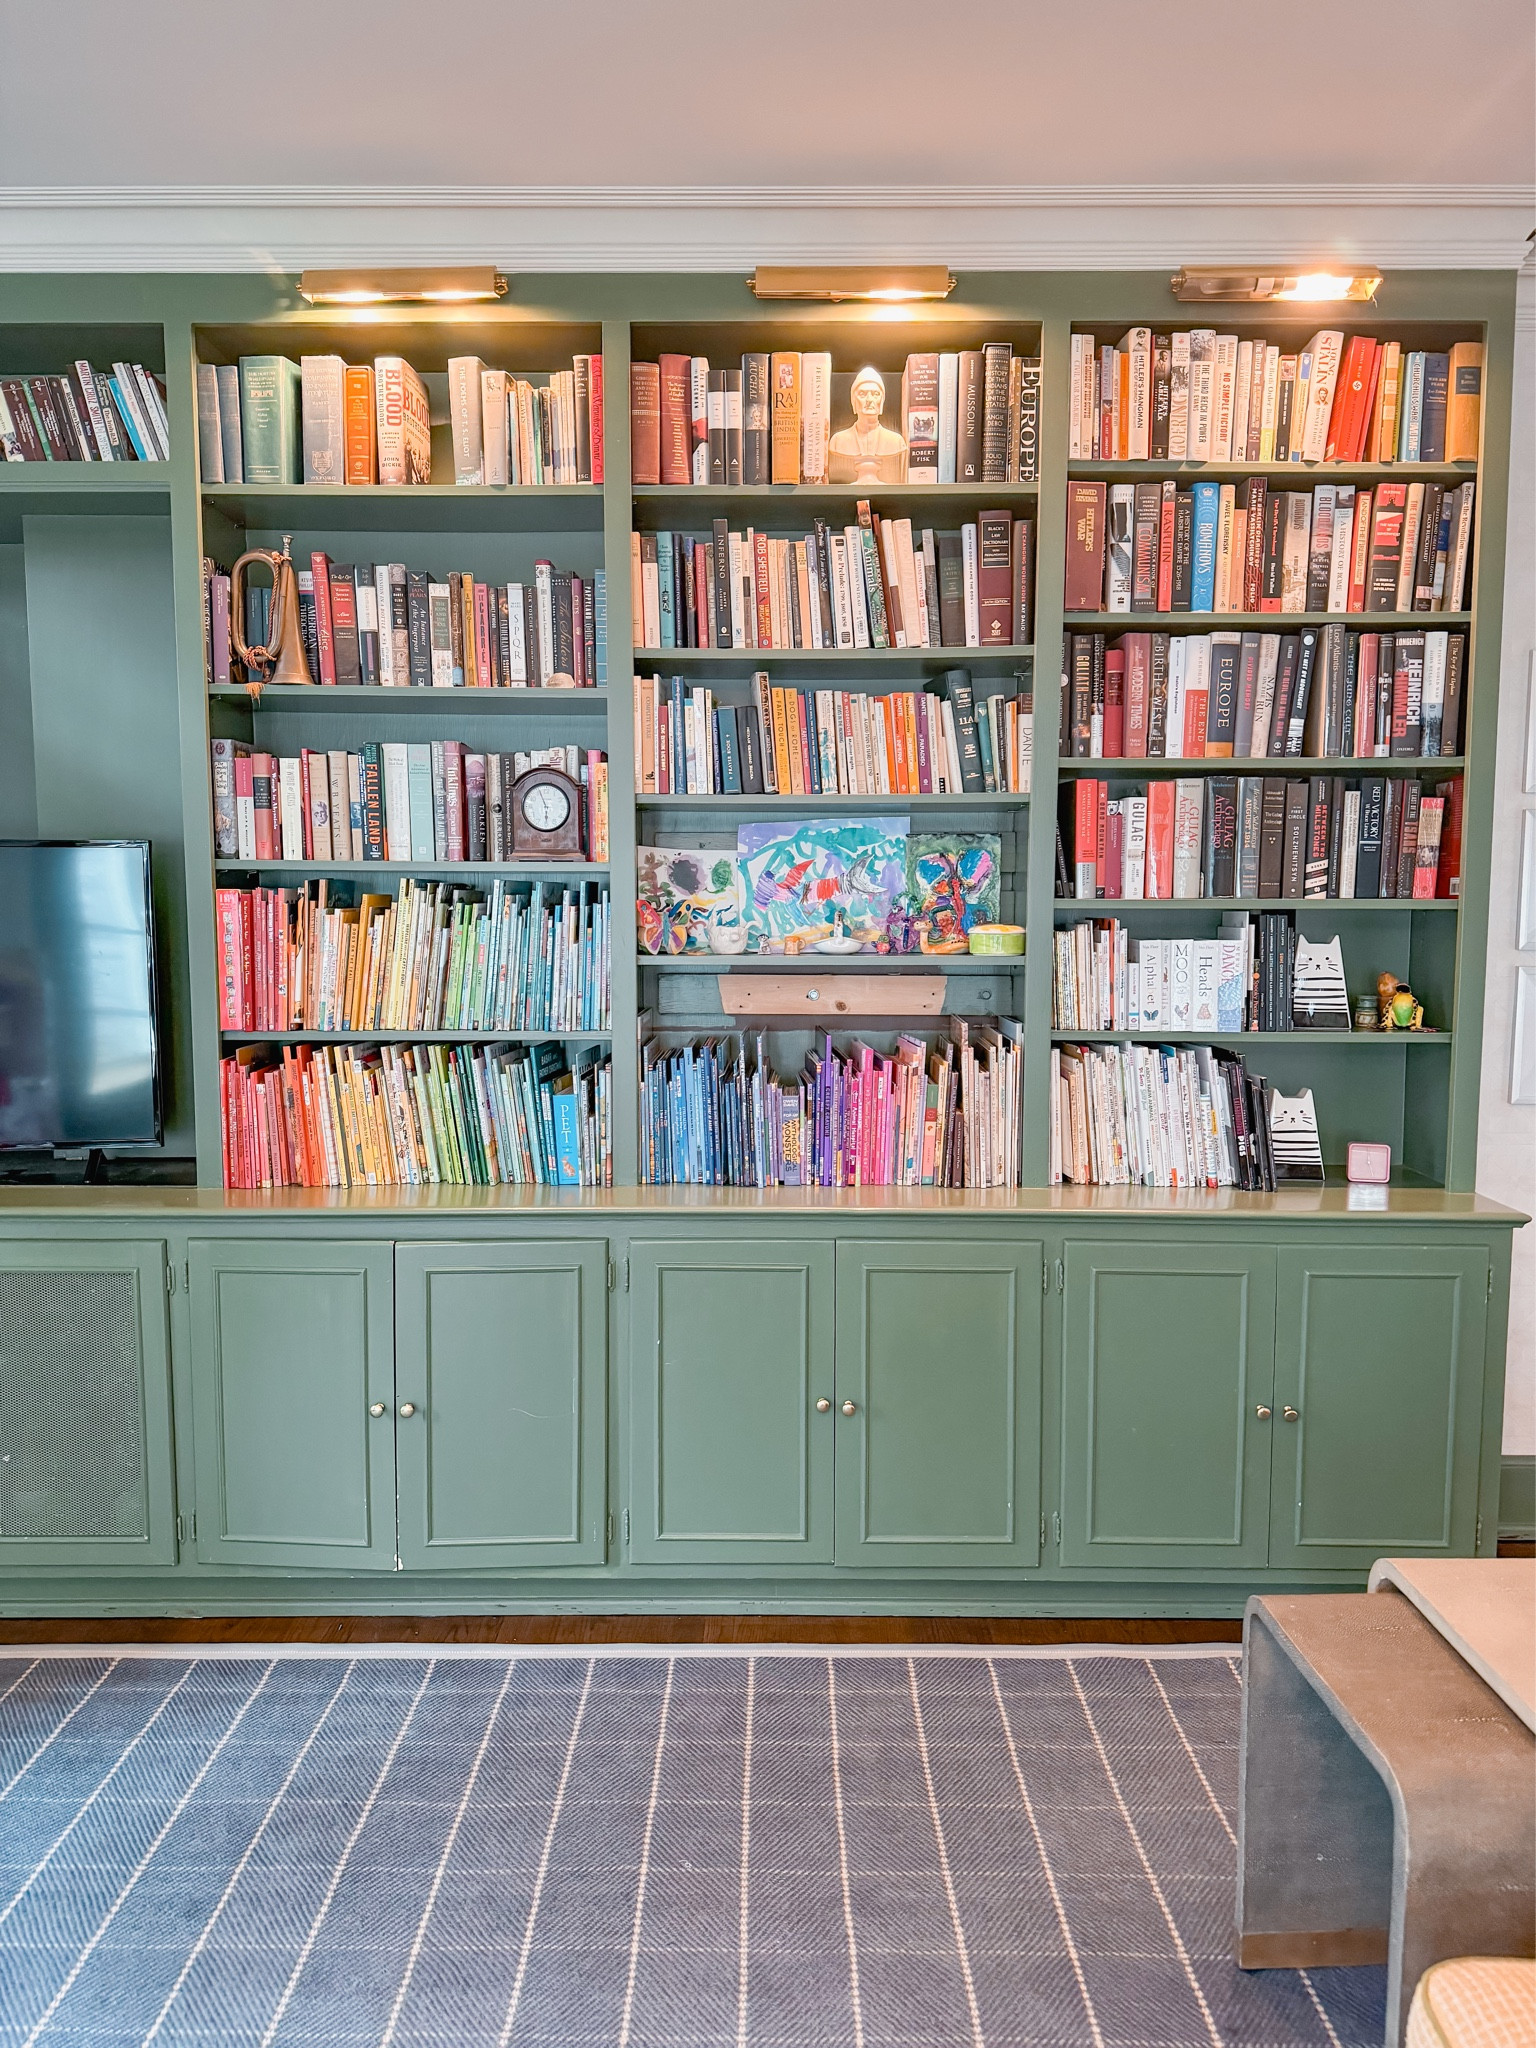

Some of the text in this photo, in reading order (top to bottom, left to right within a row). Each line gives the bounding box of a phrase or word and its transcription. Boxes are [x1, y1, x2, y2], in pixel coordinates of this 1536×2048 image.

[459, 367, 467, 379] THE
[1202, 365, 1210, 375] THE
[1218, 344, 1227, 364] DAVIES
[1226, 342, 1235, 367] NORMAN
[1316, 337, 1332, 388] STALIN
[1327, 347, 1338, 376] YOUNG
[78, 362, 103, 426] MARTIN CRUZ SMITH
[377, 369, 385, 428] BROTHERHOODS
[385, 369, 402, 427] BLOOD
[460, 382, 468, 406] POEMS
[749, 357, 760, 400] MUGHAL
[1201, 377, 1210, 394] THIRD
[462, 408, 468, 418] OF
[775, 392, 798, 409] RAJ
[967, 384, 976, 437] MUSSOLINI
[1161, 385, 1169, 417] HITLER'S
[1200, 395, 1209, 413] REICH
[1219, 373, 1231, 443] NO SIMPLE VICTORY
[1020, 362, 1041, 482] EUROPE
[1199, 423, 1208, 443] POWER
[1410, 501, 1419, 513] THE
[1463, 486, 1472, 505] Before
[1077, 519, 1086, 541] WAR
[1085, 508, 1095, 552] HITLER'S
[1162, 510, 1174, 563] RASPUTIN
[1177, 510, 1185, 541] HABSBURG
[1223, 521, 1231, 555] FLORENSKY
[1248, 513, 1256, 567] VASSILTCHIKOV
[1315, 497, 1332, 549] BLOODLANDS
[1407, 530, 1416, 545] DAYS
[1409, 515, 1417, 528] LAST
[1459, 518, 1469, 550] Revolution
[718, 535, 726, 579] INFERNO
[734, 548, 742, 574] HELLAS
[757, 537, 769, 593] ROB SHEFFIELD
[1136, 528, 1152, 594] COMMUNISM
[1198, 523, 1214, 574] ROMANOVS
[1404, 556, 1413, 576] STALIN
[865, 547, 878, 593] Animals
[584, 587, 592, 620] PAPPYLAND
[307, 603, 317, 649] AMERICAN
[411, 621, 420, 652] Fingerpost
[501, 620, 510, 655] FATHERLAND
[559, 597, 573, 668] The Sisters
[1075, 656, 1090, 692] GOLIATH
[1153, 646, 1165, 727] BIRTH WEST
[1217, 658, 1234, 728] EUROPE
[1244, 657, 1255, 710] DIVIDED MEMORY
[1264, 677, 1274, 708] NAZIS
[1368, 675, 1376, 702] Nashville
[1406, 659, 1423, 725] HEINRICH
[1130, 667, 1145, 729] MODERN TIMES
[1199, 697, 1207, 717] THE
[1255, 700, 1264, 722] RUN
[1392, 671, 1409, 737] HIMMLER
[959, 717, 974, 725] 11A
[918, 739, 926, 766] PARADISO
[1022, 727, 1034, 766] DANTE
[366, 764, 381, 845] FALLEN LAND
[1130, 802, 1146, 842] GULAG
[1175, 795, 1191, 849] Archipelago
[1211, 794, 1227, 849] Archipelago
[1369, 786, 1382, 839] RED VICTORY
[1188, 806, 1201, 849] GULAG
[1224, 805, 1236, 848] GULAG
[1312, 805, 1322, 858] MILLSTONES
[1319, 805, 1328, 858] BETWEEN TWO
[1402, 821, 1419, 854] TSARS
[1291, 826, 1300, 883] SOLZHENITSYN
[1198, 956, 1213, 998] Heads
[560, 1105, 577, 1146] PET
[784, 1119, 793, 1172] MONSTERS
[791, 1119, 800, 1172] MYTHOLOGICAL
[850, 1106, 859, 1150] Animal Hospital
[1237, 1135, 1248, 1157] PIGS
